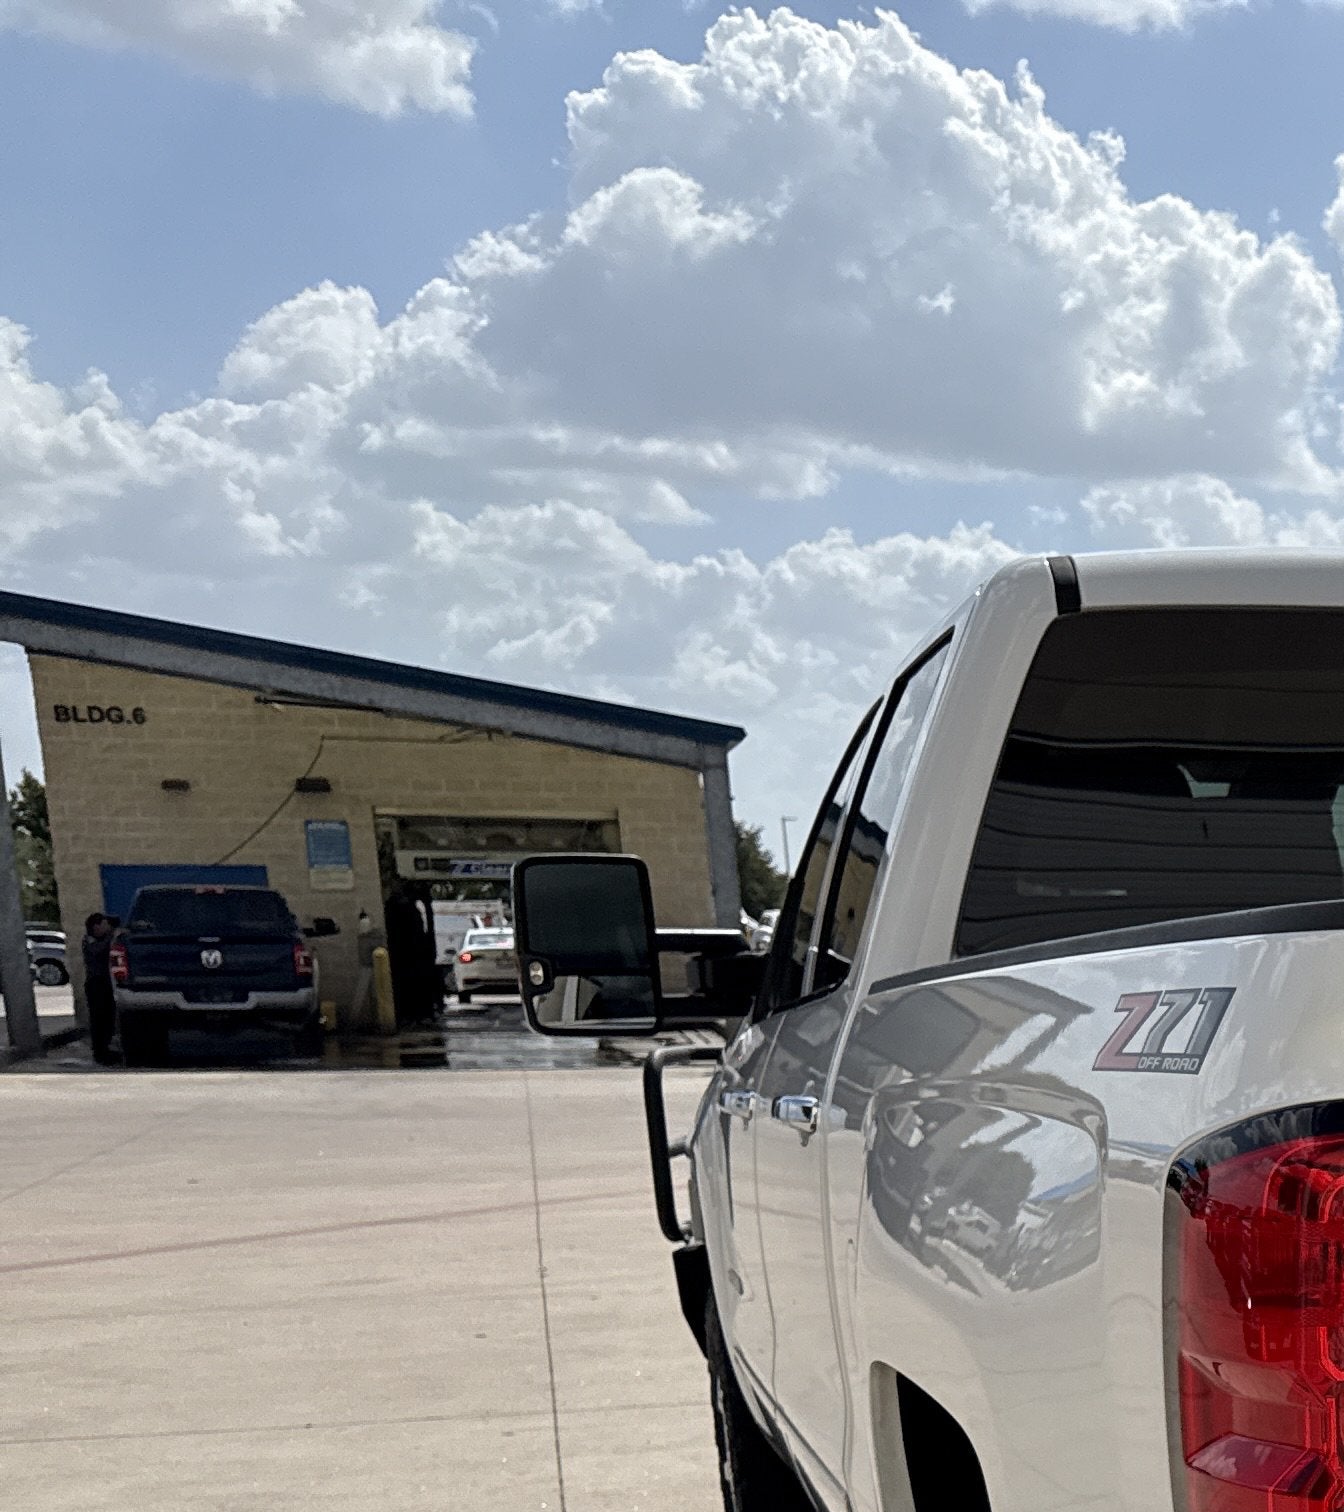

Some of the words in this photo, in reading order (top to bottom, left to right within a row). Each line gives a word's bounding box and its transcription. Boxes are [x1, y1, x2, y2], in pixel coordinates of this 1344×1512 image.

[1093, 987, 1236, 1072] Z71
[1138, 1056, 1162, 1069] OFF
[1162, 1057, 1200, 1071] ROAD
